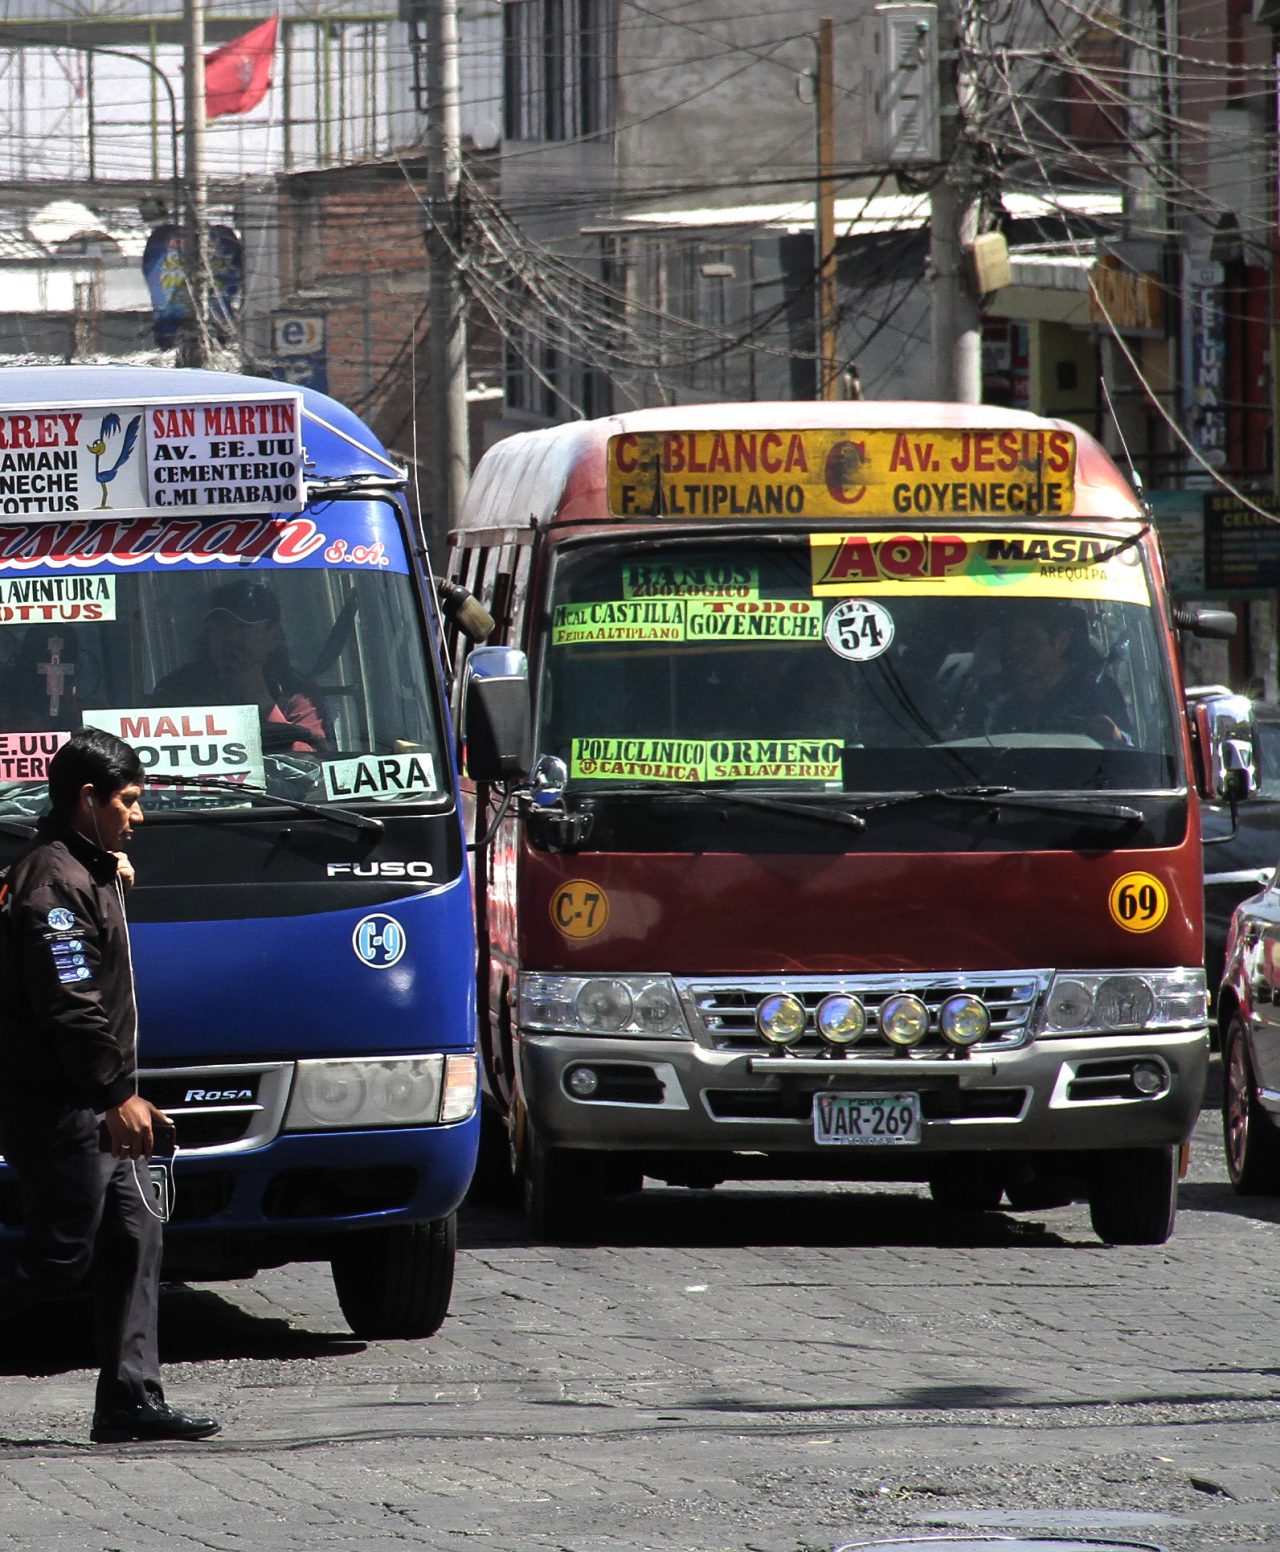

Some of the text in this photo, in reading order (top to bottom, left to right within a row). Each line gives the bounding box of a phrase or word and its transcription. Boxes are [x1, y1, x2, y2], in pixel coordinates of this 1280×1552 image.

[152, 403, 295, 439] SAN MARTIN
[209, 439, 295, 459] EE.UU
[663, 433, 808, 474] BLANCA
[951, 431, 1070, 473] JESUS
[154, 461, 295, 484] CEMENTERIO
[155, 483, 297, 507] C.MI TRABAJO
[649, 484, 805, 514] ALTIPLANO
[893, 482, 1062, 513] GOYENECHE
[826, 535, 1141, 579] AQP MASIVO
[1040, 564, 1108, 582] AREQUIPA
[8, 577, 111, 603] AVENTURA
[632, 583, 751, 598] ZOOLOGICO
[589, 601, 684, 625] CASTILLA
[703, 601, 810, 614] TODO
[595, 627, 680, 640] ALTIPLANO
[690, 614, 820, 638] GOYENECHE
[837, 614, 884, 651] 54
[120, 714, 228, 739] MALL
[133, 743, 248, 768] OTUS
[576, 738, 841, 765] POLICLINICO ORMEÑO
[329, 757, 432, 796] LARA
[600, 762, 700, 780] CATOLICA
[714, 764, 840, 778] SALAVERRY
[326, 861, 433, 877] FUSO
[556, 892, 600, 928] C-7
[1118, 884, 1158, 921] 69
[358, 921, 401, 961] C-9
[820, 1105, 913, 1135] VAR-269
